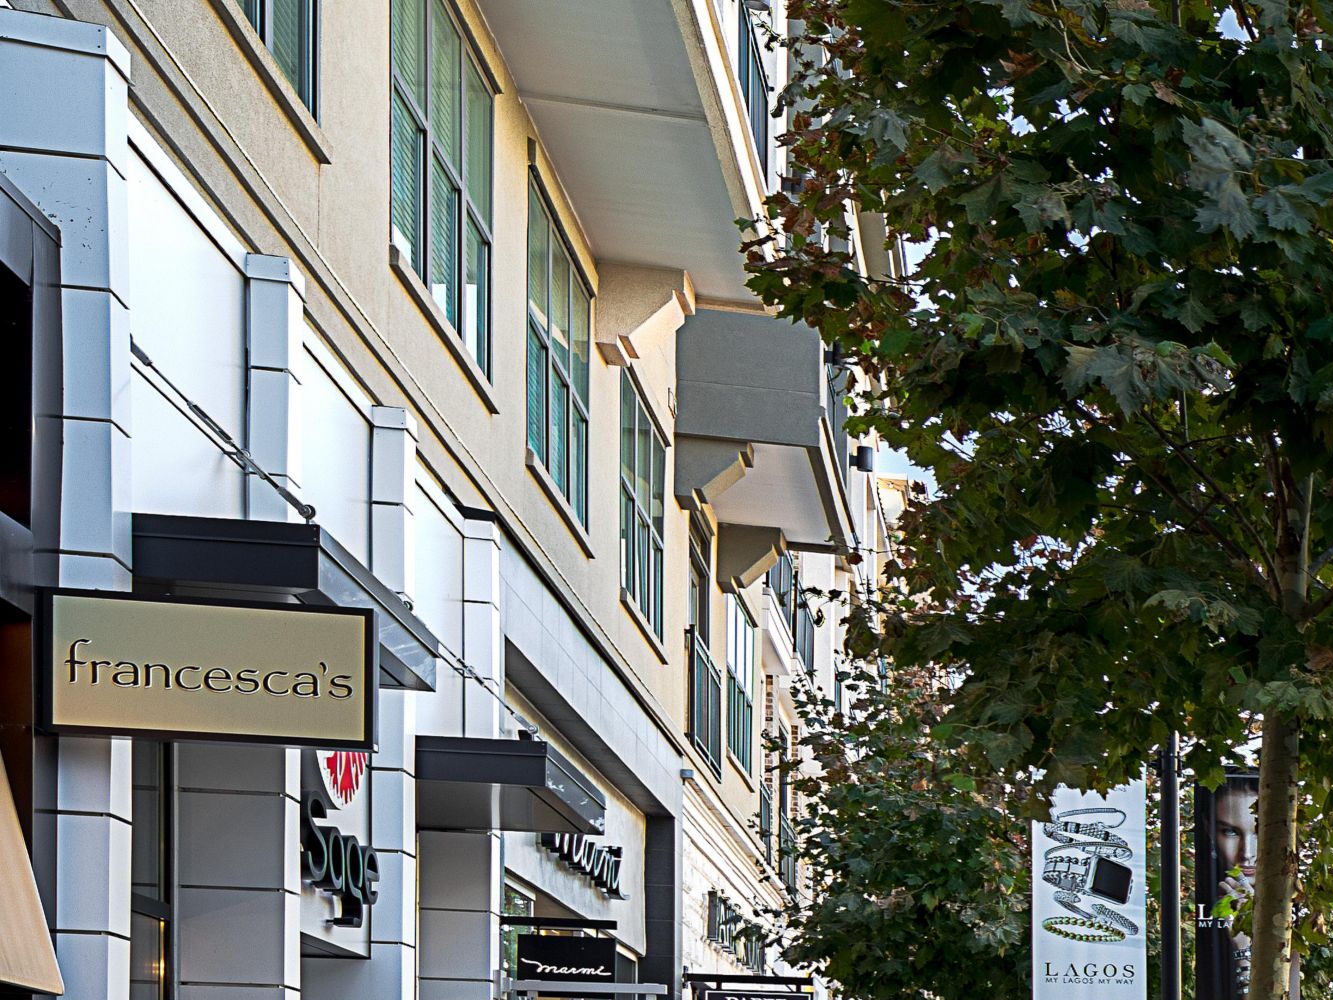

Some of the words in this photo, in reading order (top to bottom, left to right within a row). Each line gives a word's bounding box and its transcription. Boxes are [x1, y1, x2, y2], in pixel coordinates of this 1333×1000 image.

[64, 638, 354, 700] francesca's
[520, 957, 612, 976] marmi
[1045, 962, 1135, 978] LAGOS
